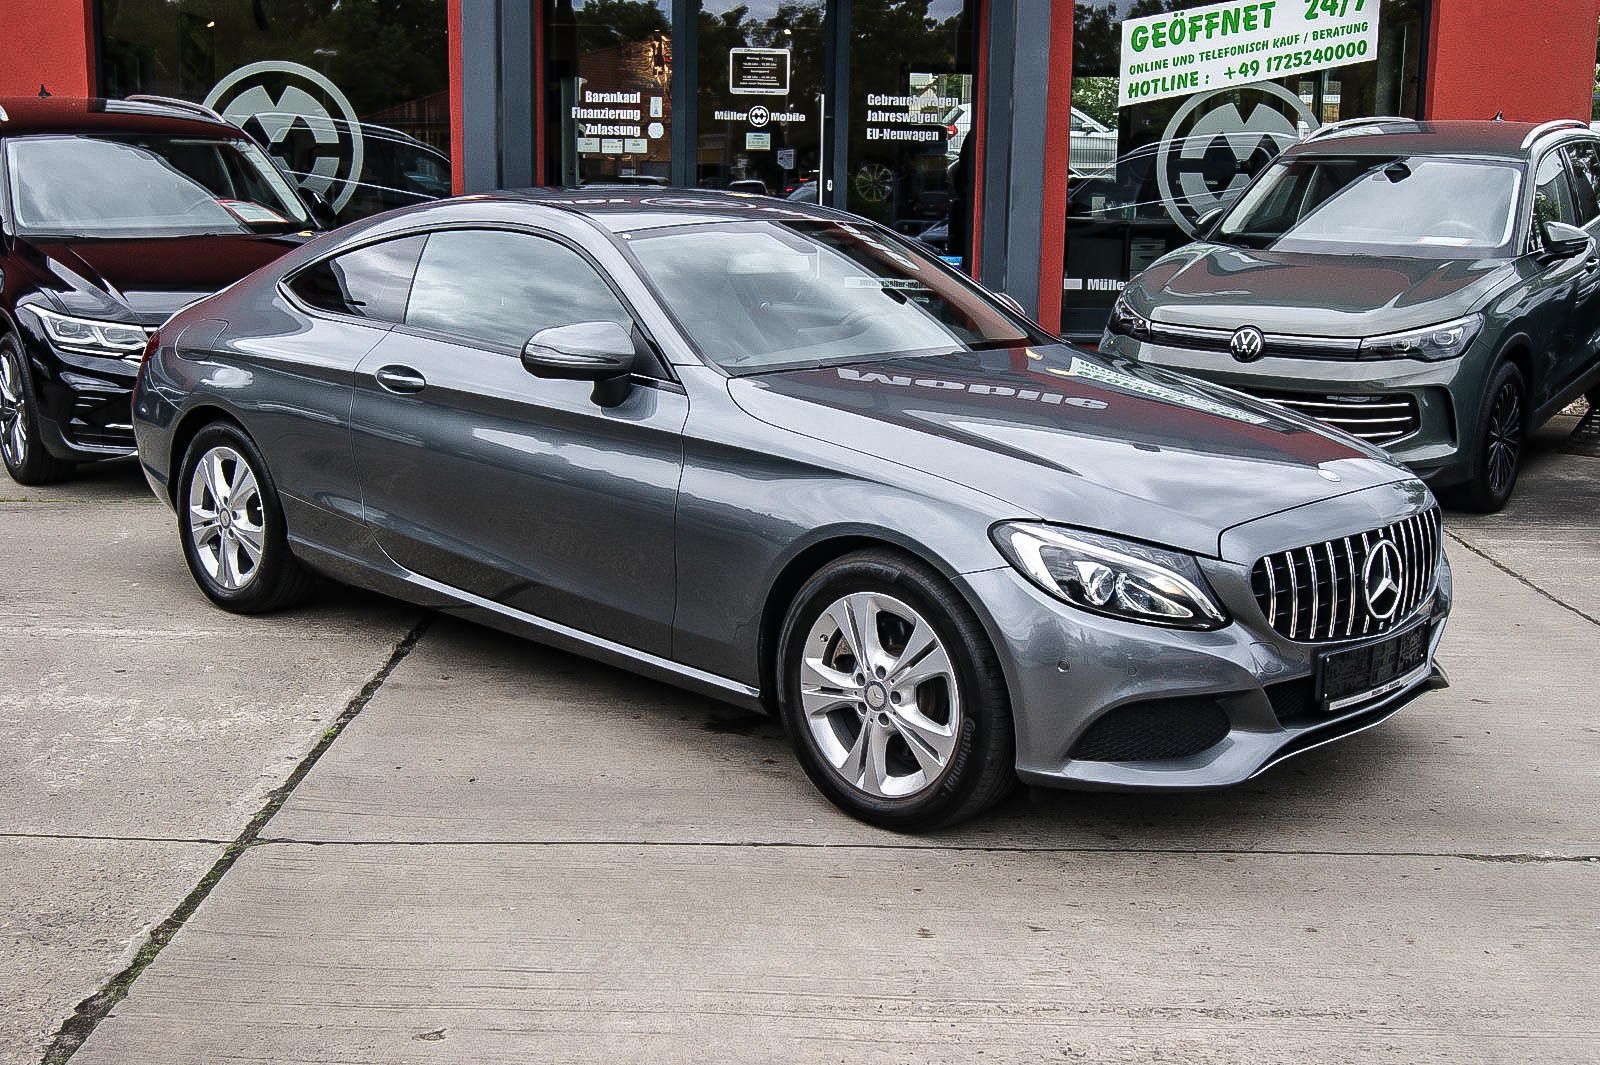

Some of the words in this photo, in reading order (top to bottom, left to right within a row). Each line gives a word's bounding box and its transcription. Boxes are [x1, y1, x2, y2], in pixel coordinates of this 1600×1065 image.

[1131, 1, 1276, 52] GEÖFFNET
[1129, 59, 1169, 75] ONLINE
[1172, 54, 1195, 67] UND
[1199, 40, 1269, 62] TELEFONISCH
[1272, 34, 1301, 49] KAUF
[1312, 21, 1369, 41] BERATUNG
[1128, 71, 1199, 99] HOTLINE
[1224, 60, 1260, 80] +49
[1266, 39, 1368, 73] 1725240000
[585, 90, 641, 104] Barankauf
[571, 106, 641, 121] Finanzierung
[714, 110, 748, 121] Müller
[770, 112, 806, 122] Mobile
[867, 109, 938, 124] Jahreswagen
[585, 123, 641, 137] Zulassung
[866, 127, 939, 142] EU-Neuwagen
[1087, 278, 1128, 291] Mülle
